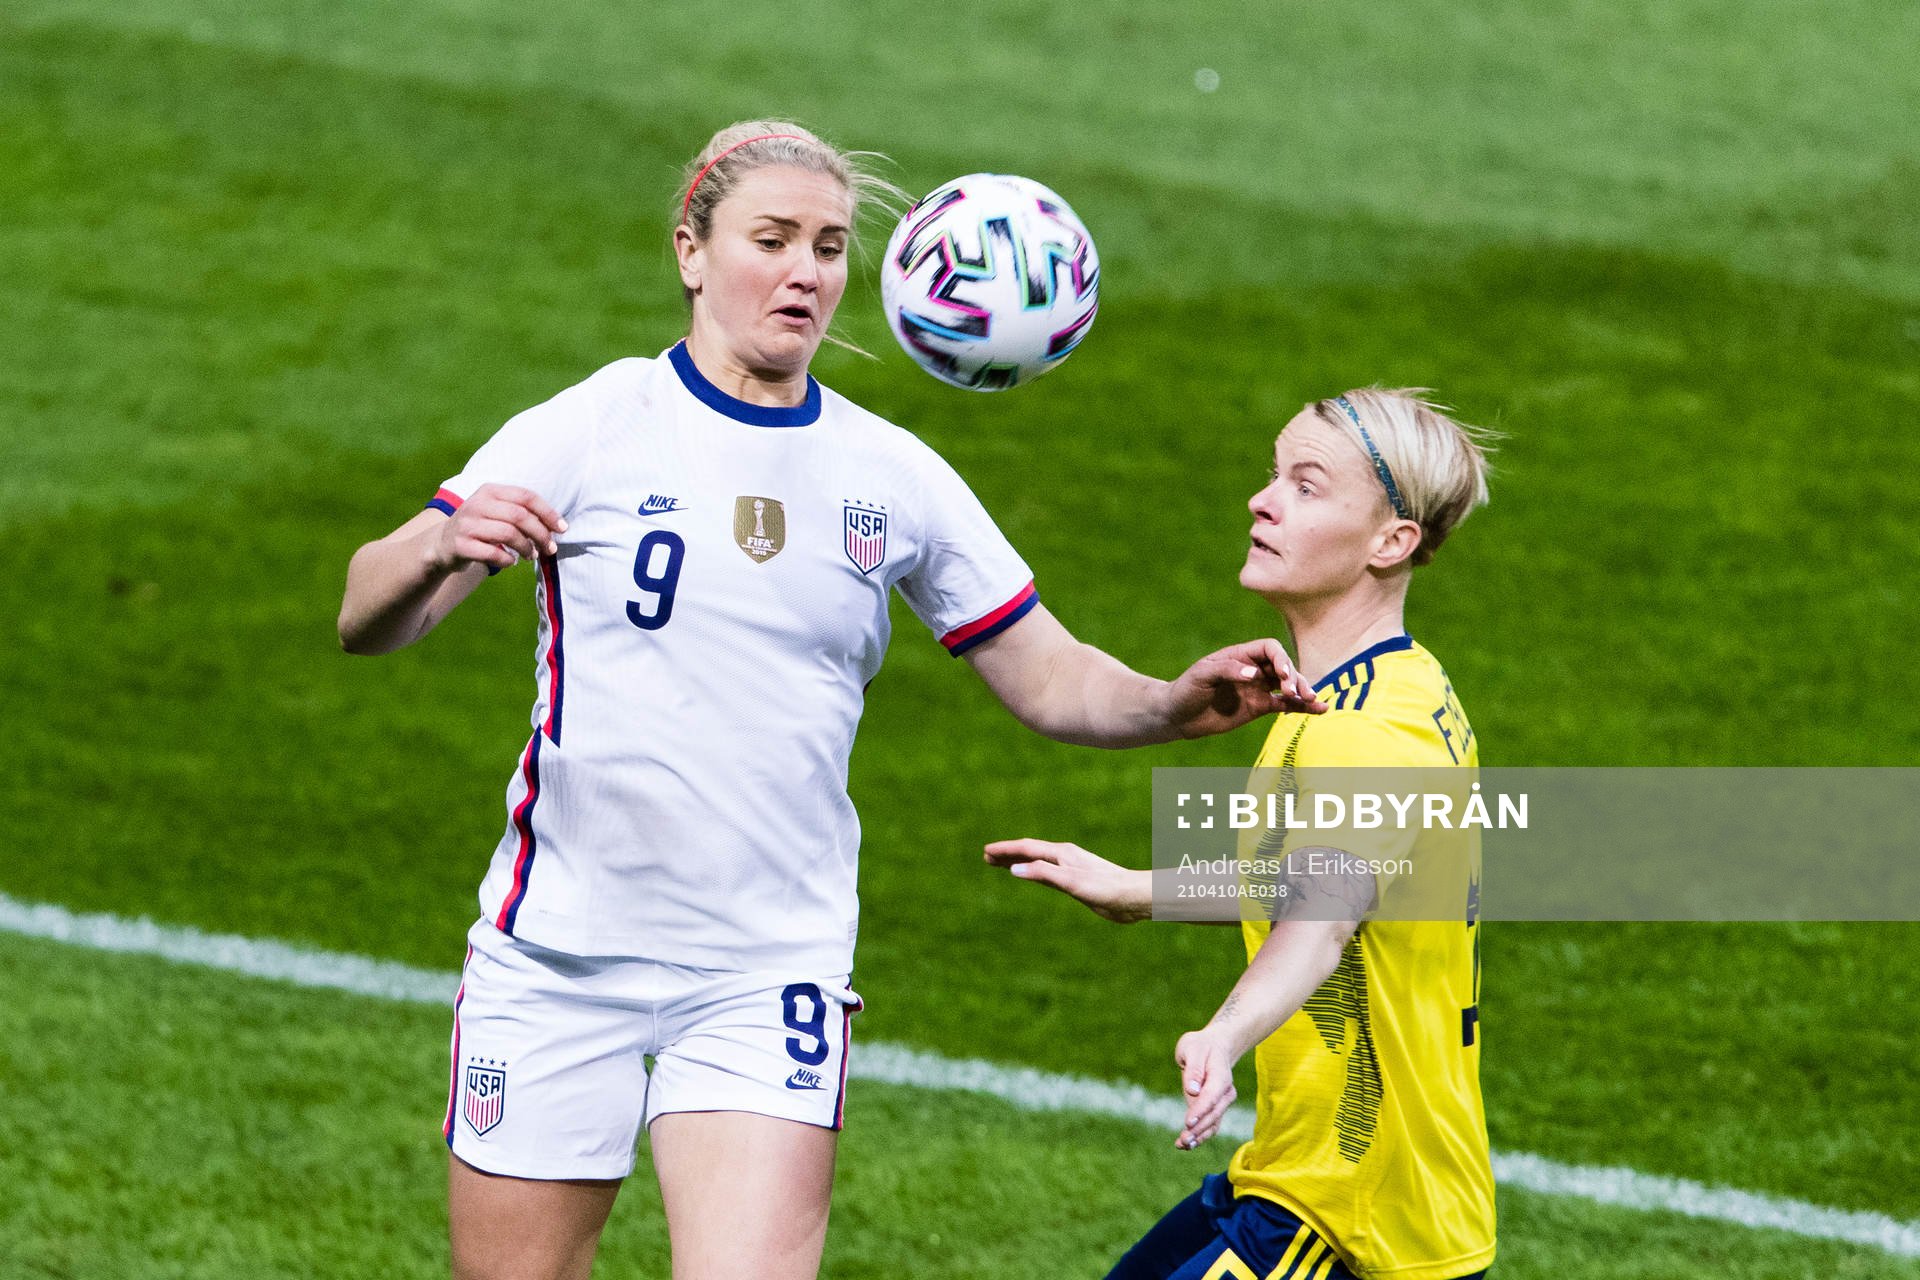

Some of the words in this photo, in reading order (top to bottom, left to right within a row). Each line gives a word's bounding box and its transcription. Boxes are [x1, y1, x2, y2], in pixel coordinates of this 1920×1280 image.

[645, 494, 679, 511] NIKE
[849, 511, 883, 538] USA
[747, 536, 772, 549] FIFA
[625, 529, 686, 631] 9
[780, 982, 830, 1066] 9
[469, 1072, 501, 1097] USA
[793, 1068, 822, 1089] NIKE
